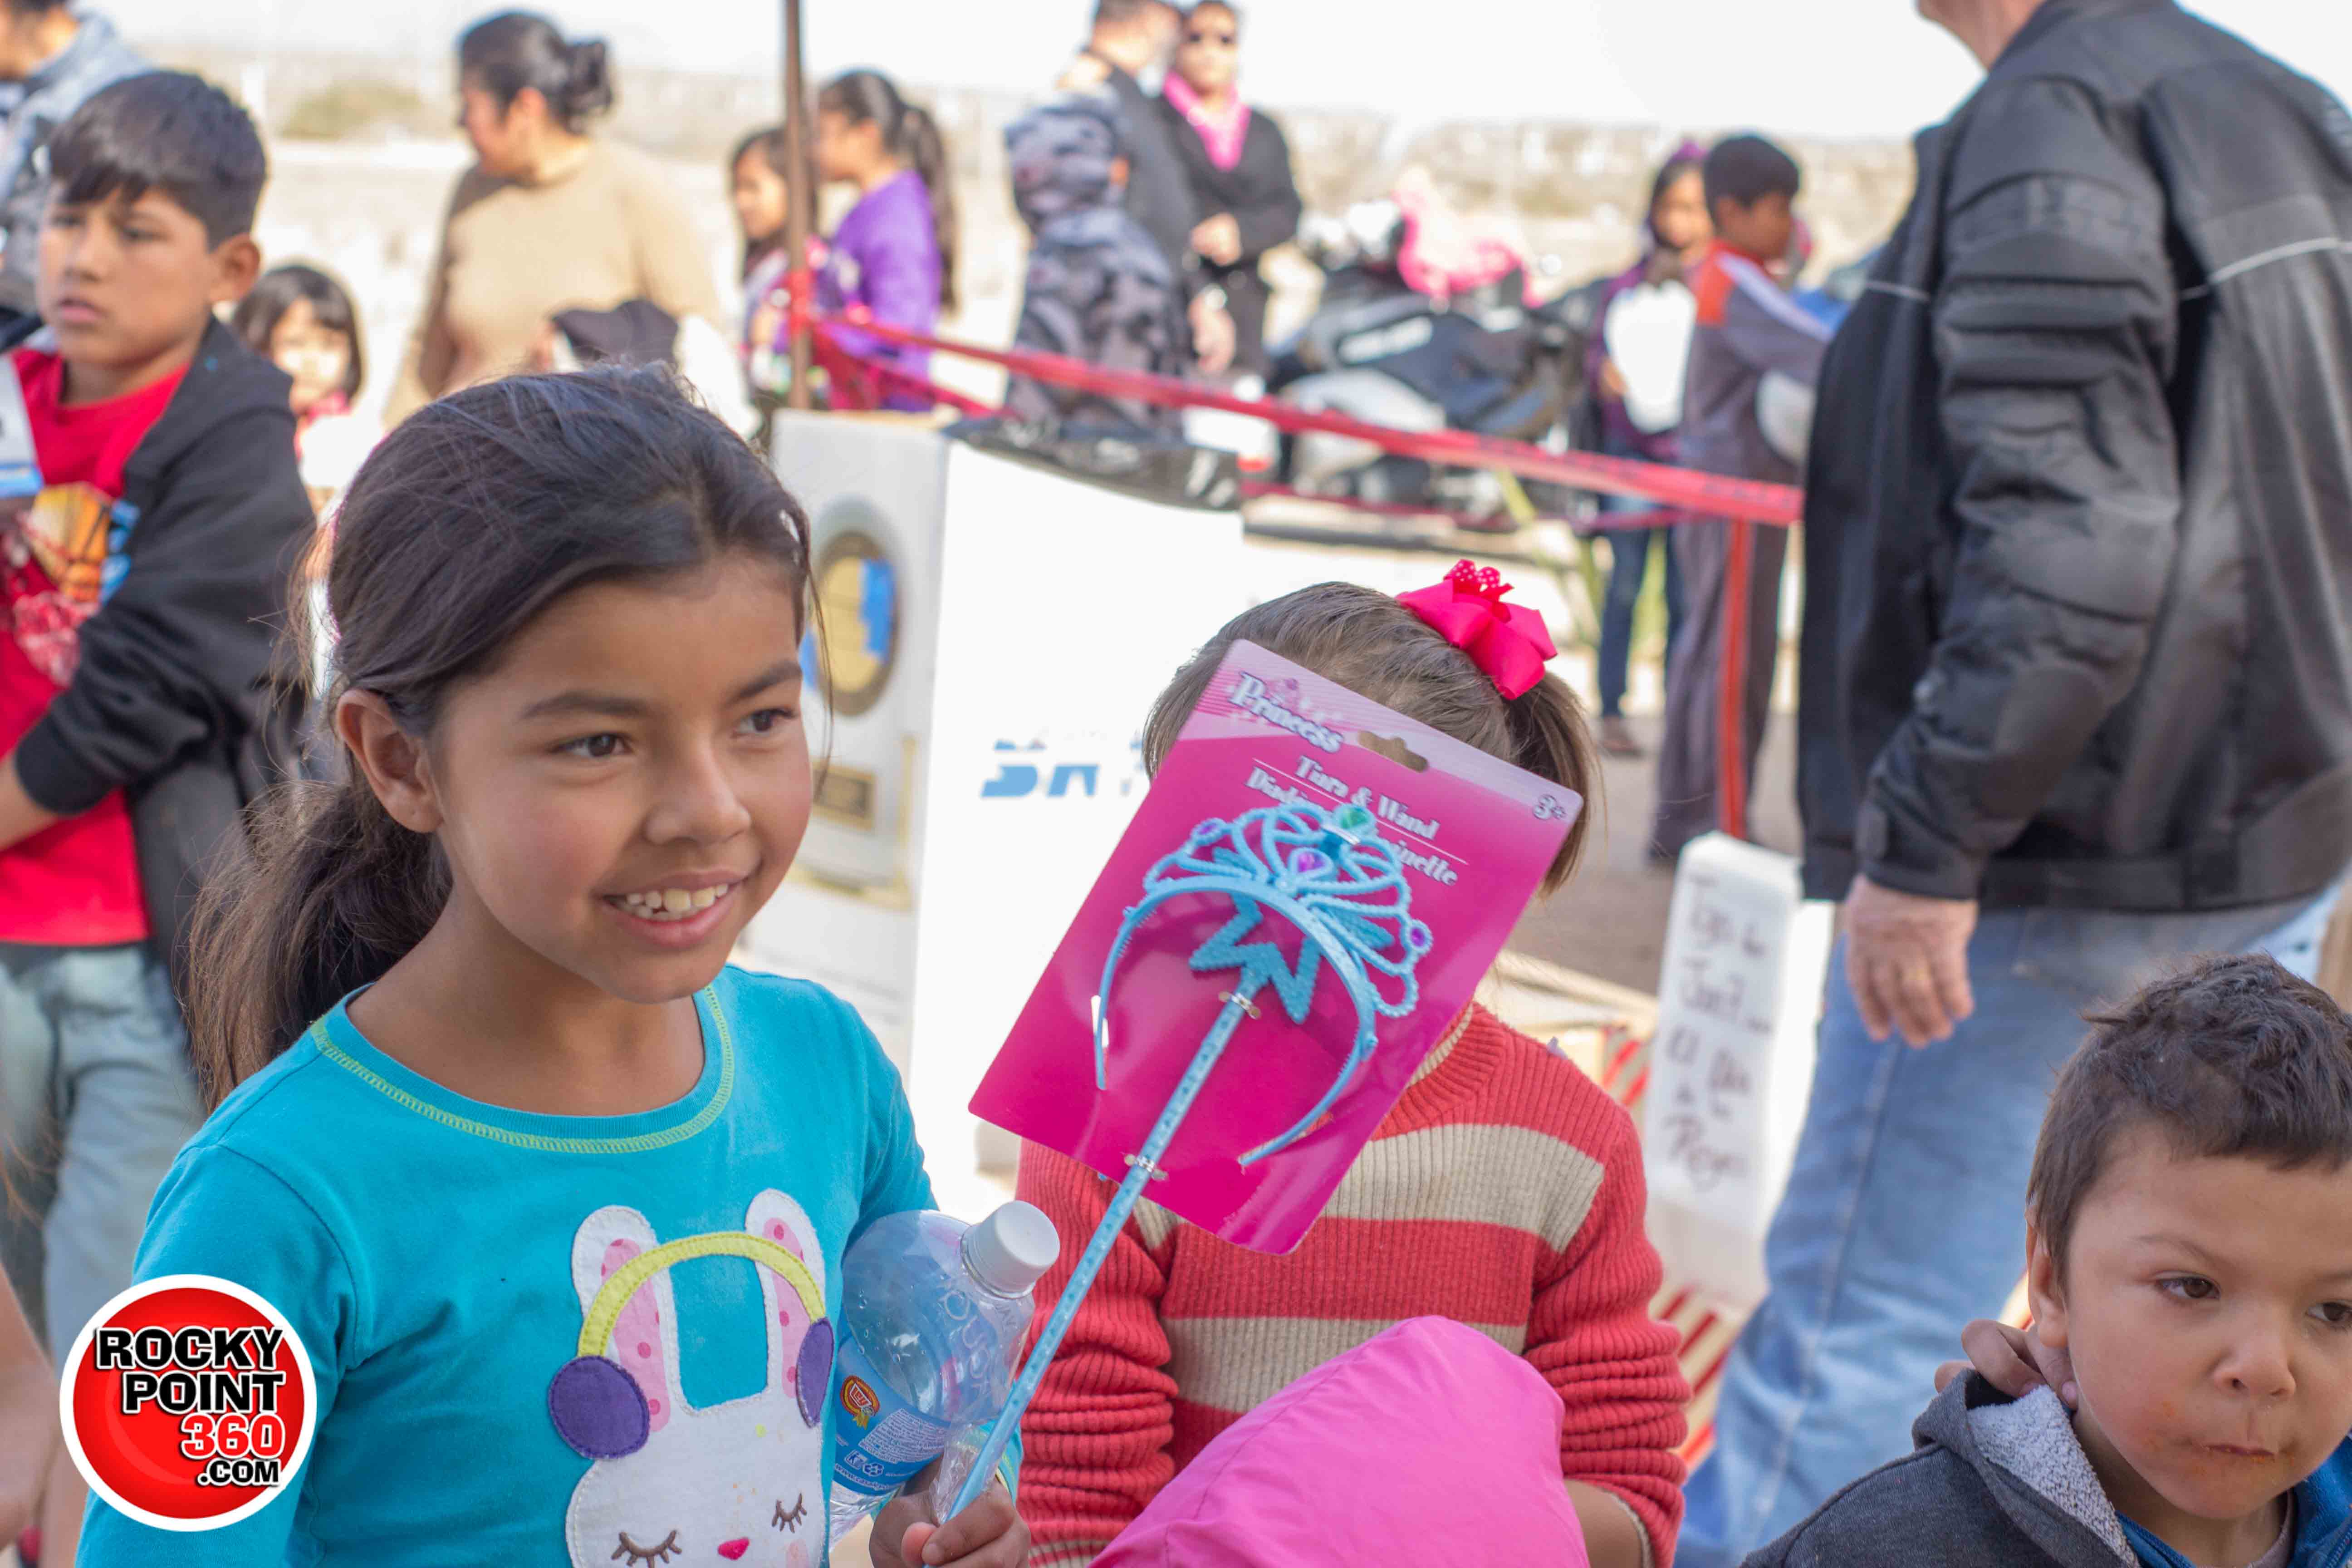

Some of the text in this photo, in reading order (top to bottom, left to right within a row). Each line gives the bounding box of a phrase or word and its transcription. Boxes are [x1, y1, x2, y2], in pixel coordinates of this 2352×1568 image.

[1227, 671, 1343, 753] Princess
[1295, 755, 1440, 839] Tiara & Wand
